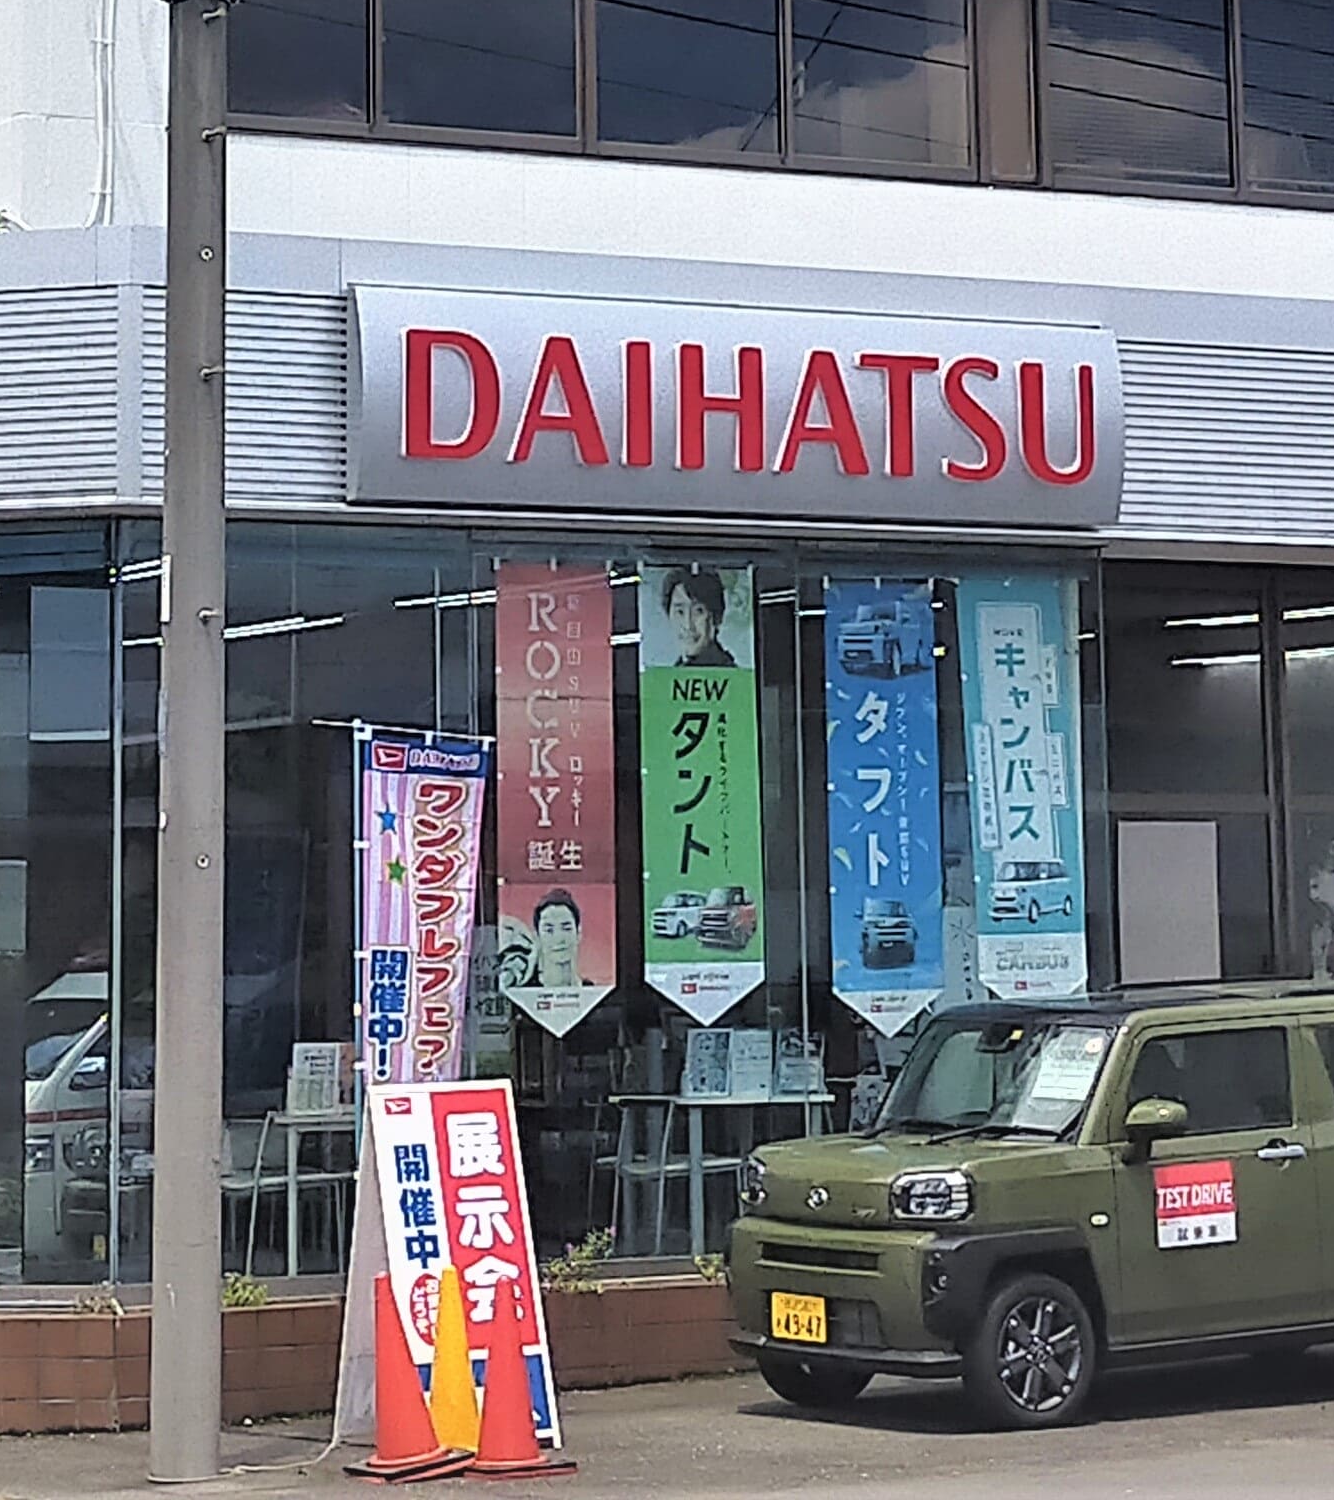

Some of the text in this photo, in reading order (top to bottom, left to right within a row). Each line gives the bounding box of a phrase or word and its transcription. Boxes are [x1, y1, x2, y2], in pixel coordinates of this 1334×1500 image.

[401, 327, 1095, 486] DAIHATSU
[526, 591, 561, 828] ROCKY
[672, 678, 729, 702] NEW
[993, 641, 1041, 842] キャンバス
[528, 840, 583, 871] 誕生
[569, 754, 584, 828] ロッキー
[671, 712, 713, 875] タント
[854, 690, 892, 887] タフト
[368, 949, 409, 1078] 開催中!
[393, 1142, 441, 1270] 開催中
[445, 1110, 525, 1323] 展示会
[1156, 1180, 1234, 1210] TEST DRIVE
